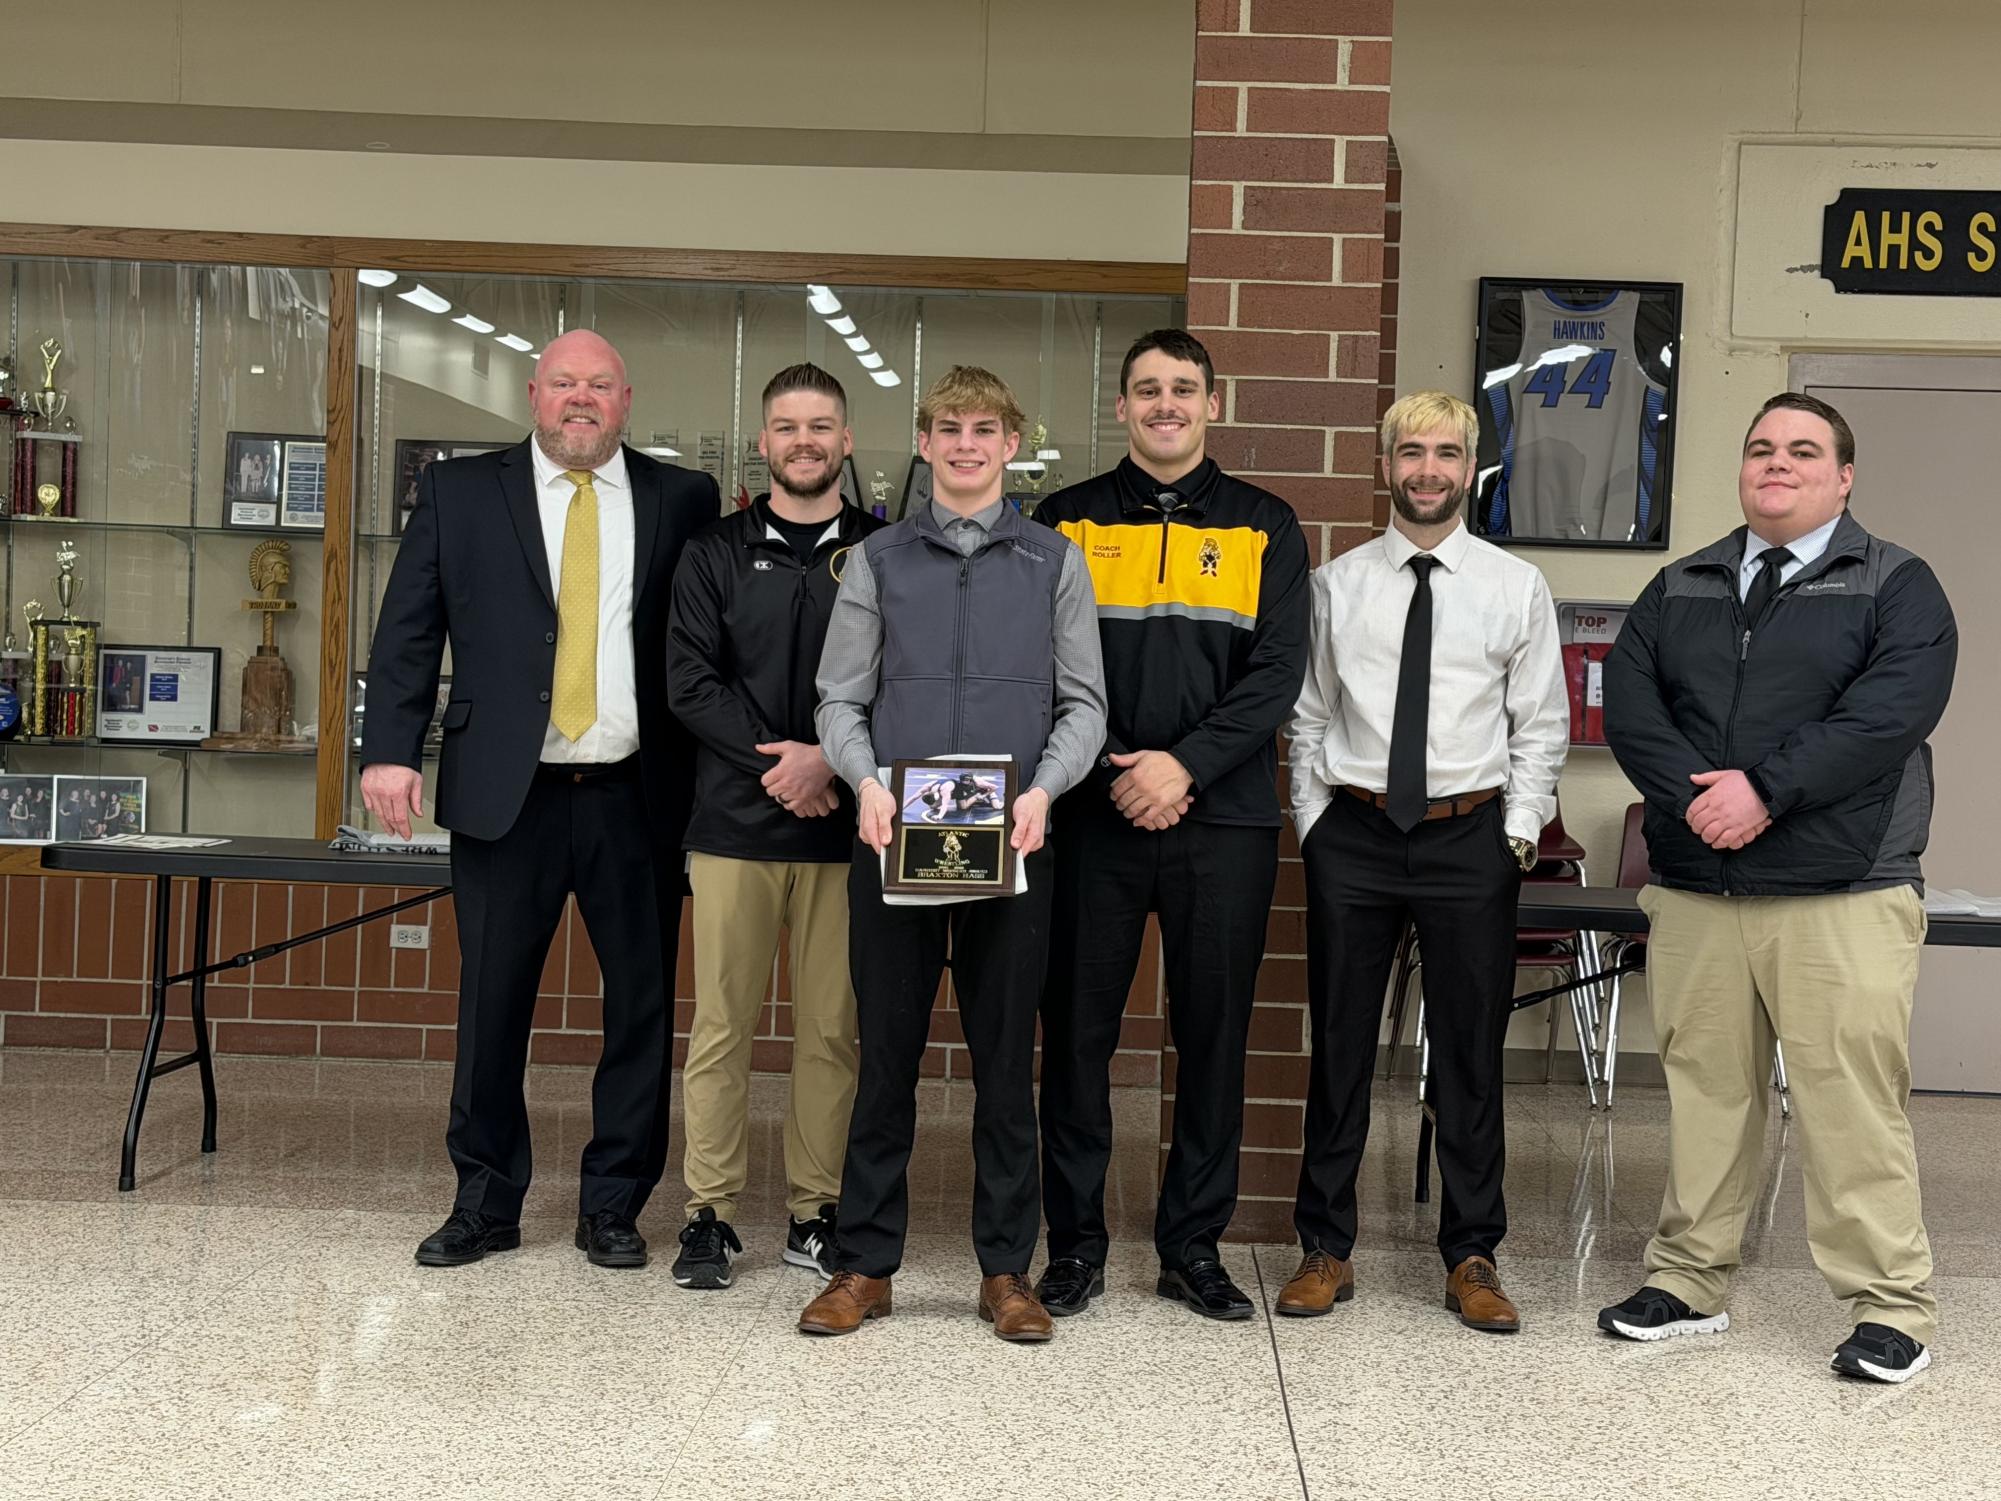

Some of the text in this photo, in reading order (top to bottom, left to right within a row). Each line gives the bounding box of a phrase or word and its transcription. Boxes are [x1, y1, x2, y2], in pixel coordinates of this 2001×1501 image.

[1841, 210, 1996, 272] AHS S
[1553, 320, 1605, 340] HAWKINS
[1522, 347, 1617, 409] 44
[1575, 615, 1608, 628] TOP
